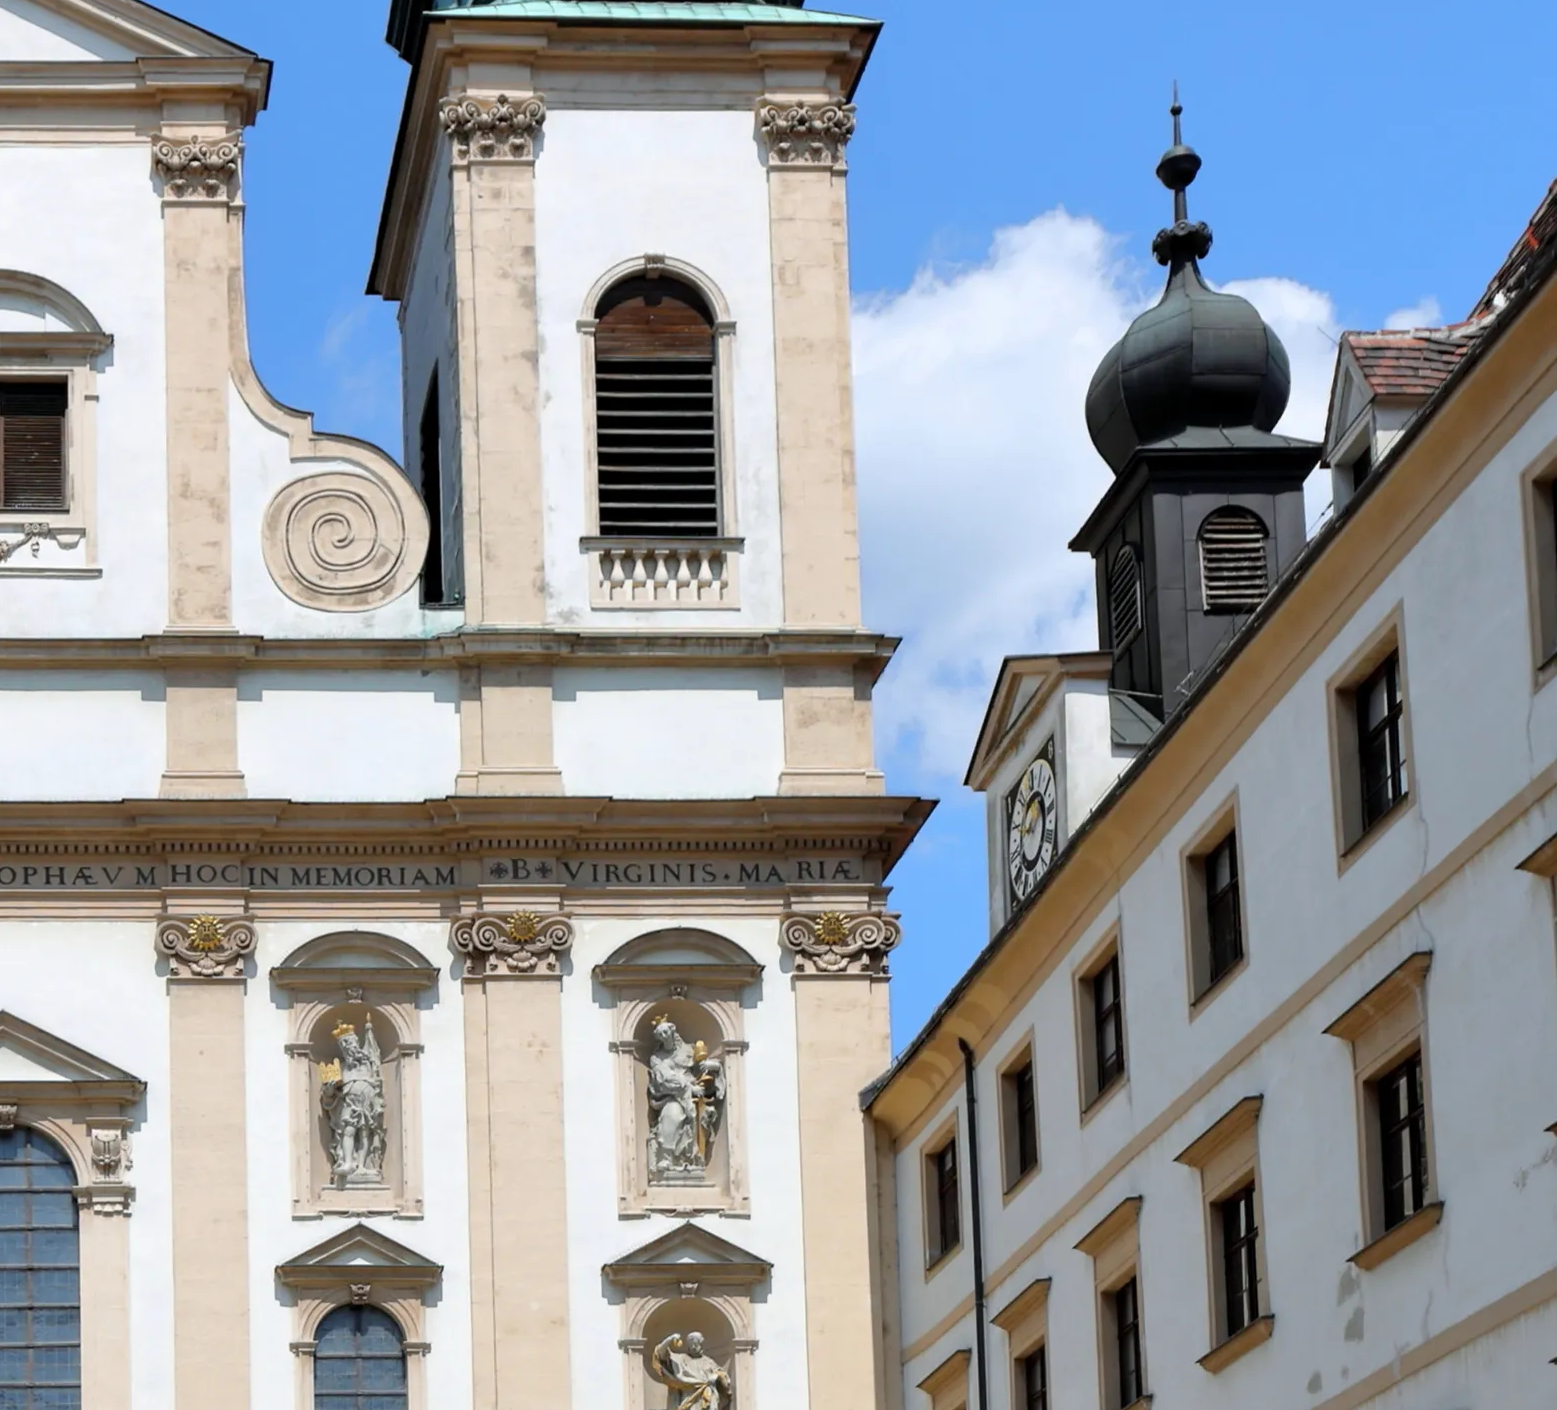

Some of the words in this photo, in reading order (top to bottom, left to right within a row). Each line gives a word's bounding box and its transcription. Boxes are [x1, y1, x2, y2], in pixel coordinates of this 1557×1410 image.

[170, 863, 239, 884] HOC
[247, 866, 280, 886] IN
[290, 865, 456, 887] MEMORIAM
